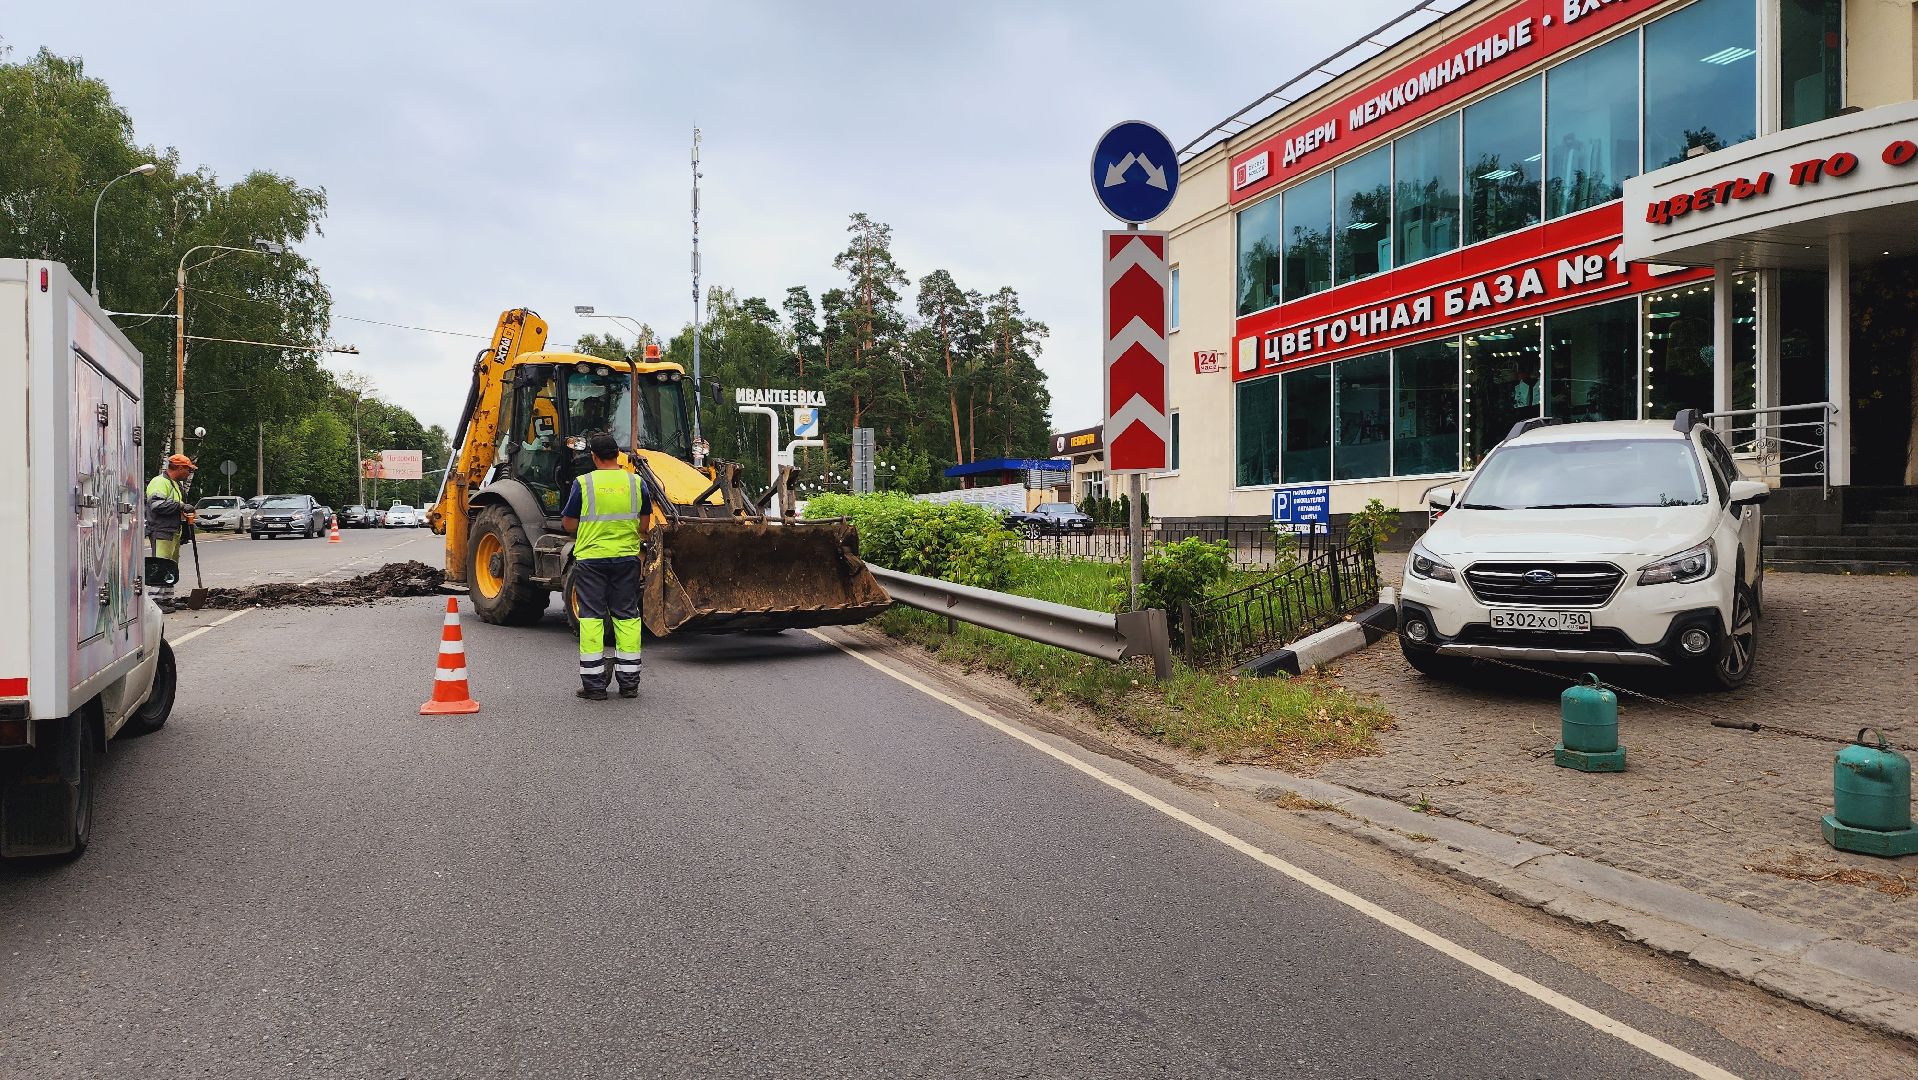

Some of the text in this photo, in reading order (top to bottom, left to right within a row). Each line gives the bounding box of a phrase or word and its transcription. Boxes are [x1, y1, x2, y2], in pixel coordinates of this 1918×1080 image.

[1283, 119, 1336, 168] ДВЕРИ
[1349, 17, 1532, 131] МЕЖКОМНАТНЫЕ
[1646, 172, 1773, 224] ЦВЕТЫ
[1789, 152, 1858, 185] ПО
[1265, 296, 1431, 361] ЦВЕТОЧНАЯ
[1444, 268, 1544, 316] БАЗА
[1201, 353, 1216, 365] 24
[736, 387, 826, 406] ИВАНТЕЕВКА
[1278, 494, 1287, 518] P
[1495, 612, 1586, 628] В302ХО 750
